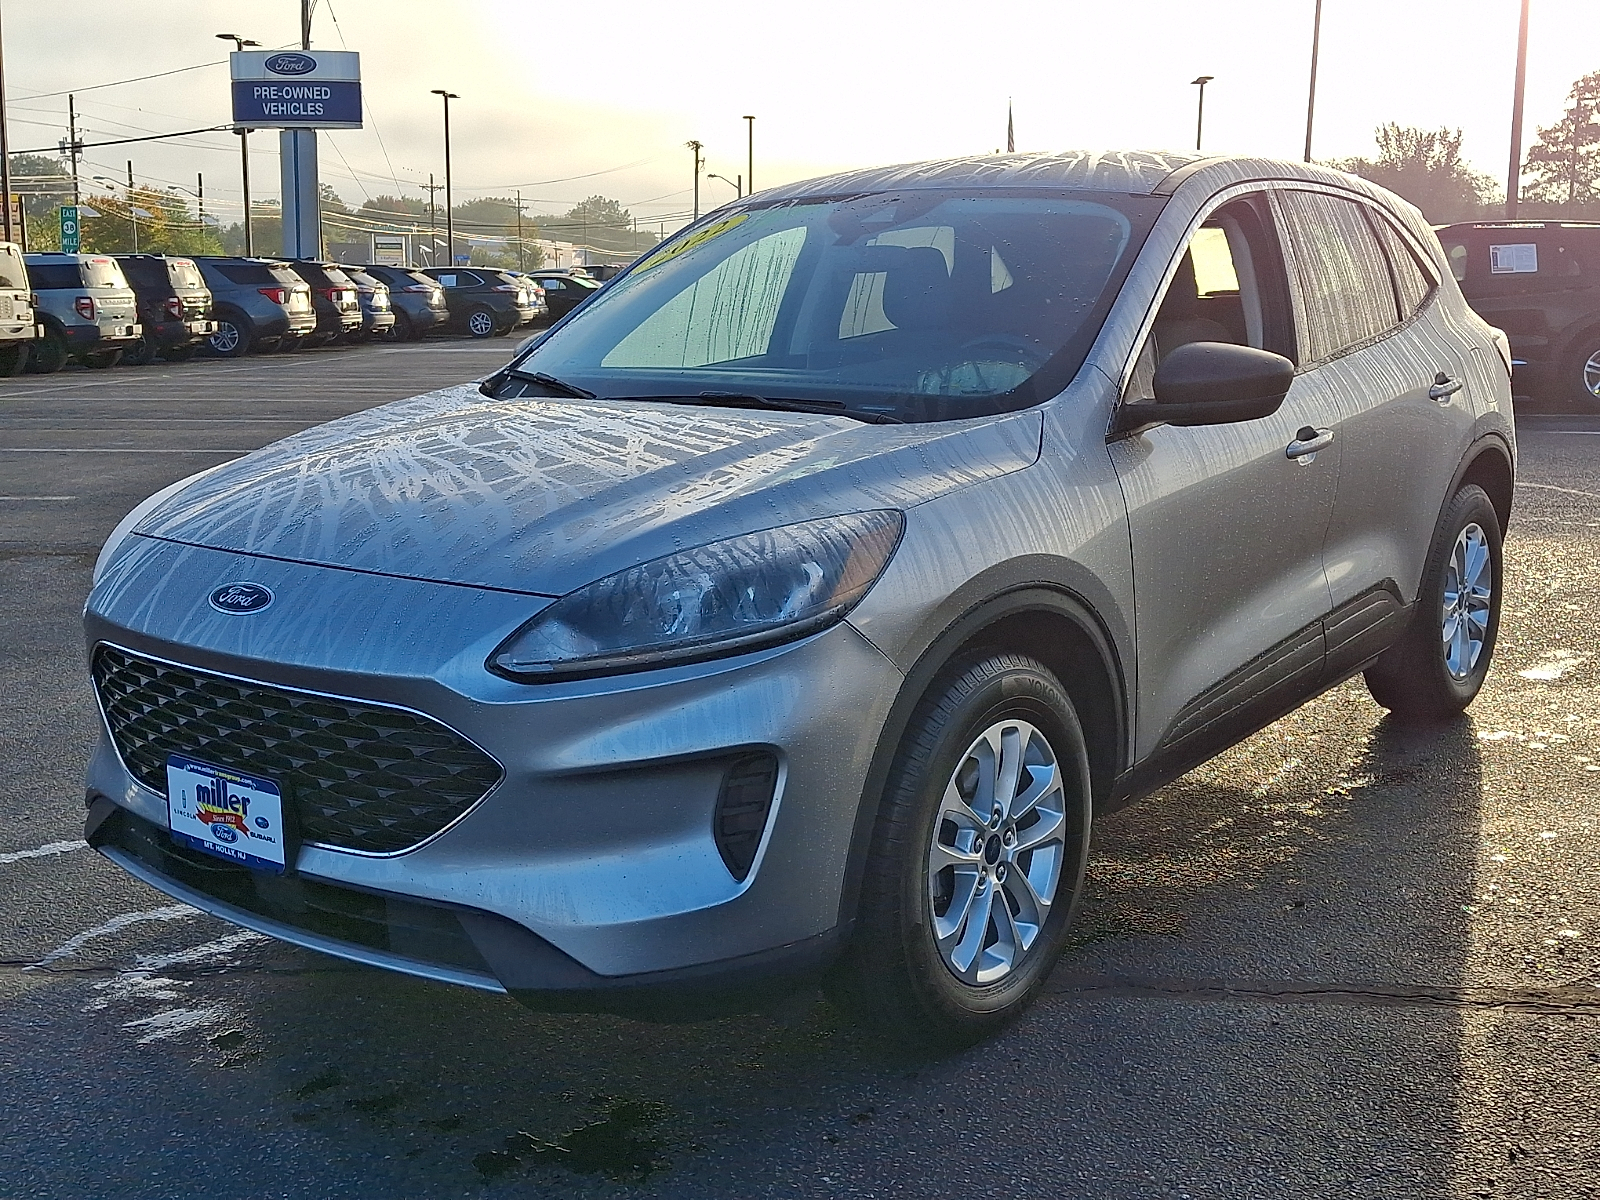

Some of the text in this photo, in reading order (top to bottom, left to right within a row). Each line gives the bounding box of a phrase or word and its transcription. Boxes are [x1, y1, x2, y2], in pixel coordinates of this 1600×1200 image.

[275, 57, 305, 71] Ford
[253, 86, 331, 99] PRE-OWNED
[262, 102, 324, 115] VEHICLES
[62, 209, 75, 217] EAST
[64, 223, 75, 232] 38
[62, 238, 77, 246] MILE
[218, 586, 260, 607] Ford
[195, 778, 251, 816] miller
[173, 808, 197, 821] LINCOLN
[212, 814, 225, 822] Since
[215, 825, 233, 841] Ford
[249, 831, 277, 844] SUBARU
[203, 841, 246, 860] MT. HOLLY, NJ
